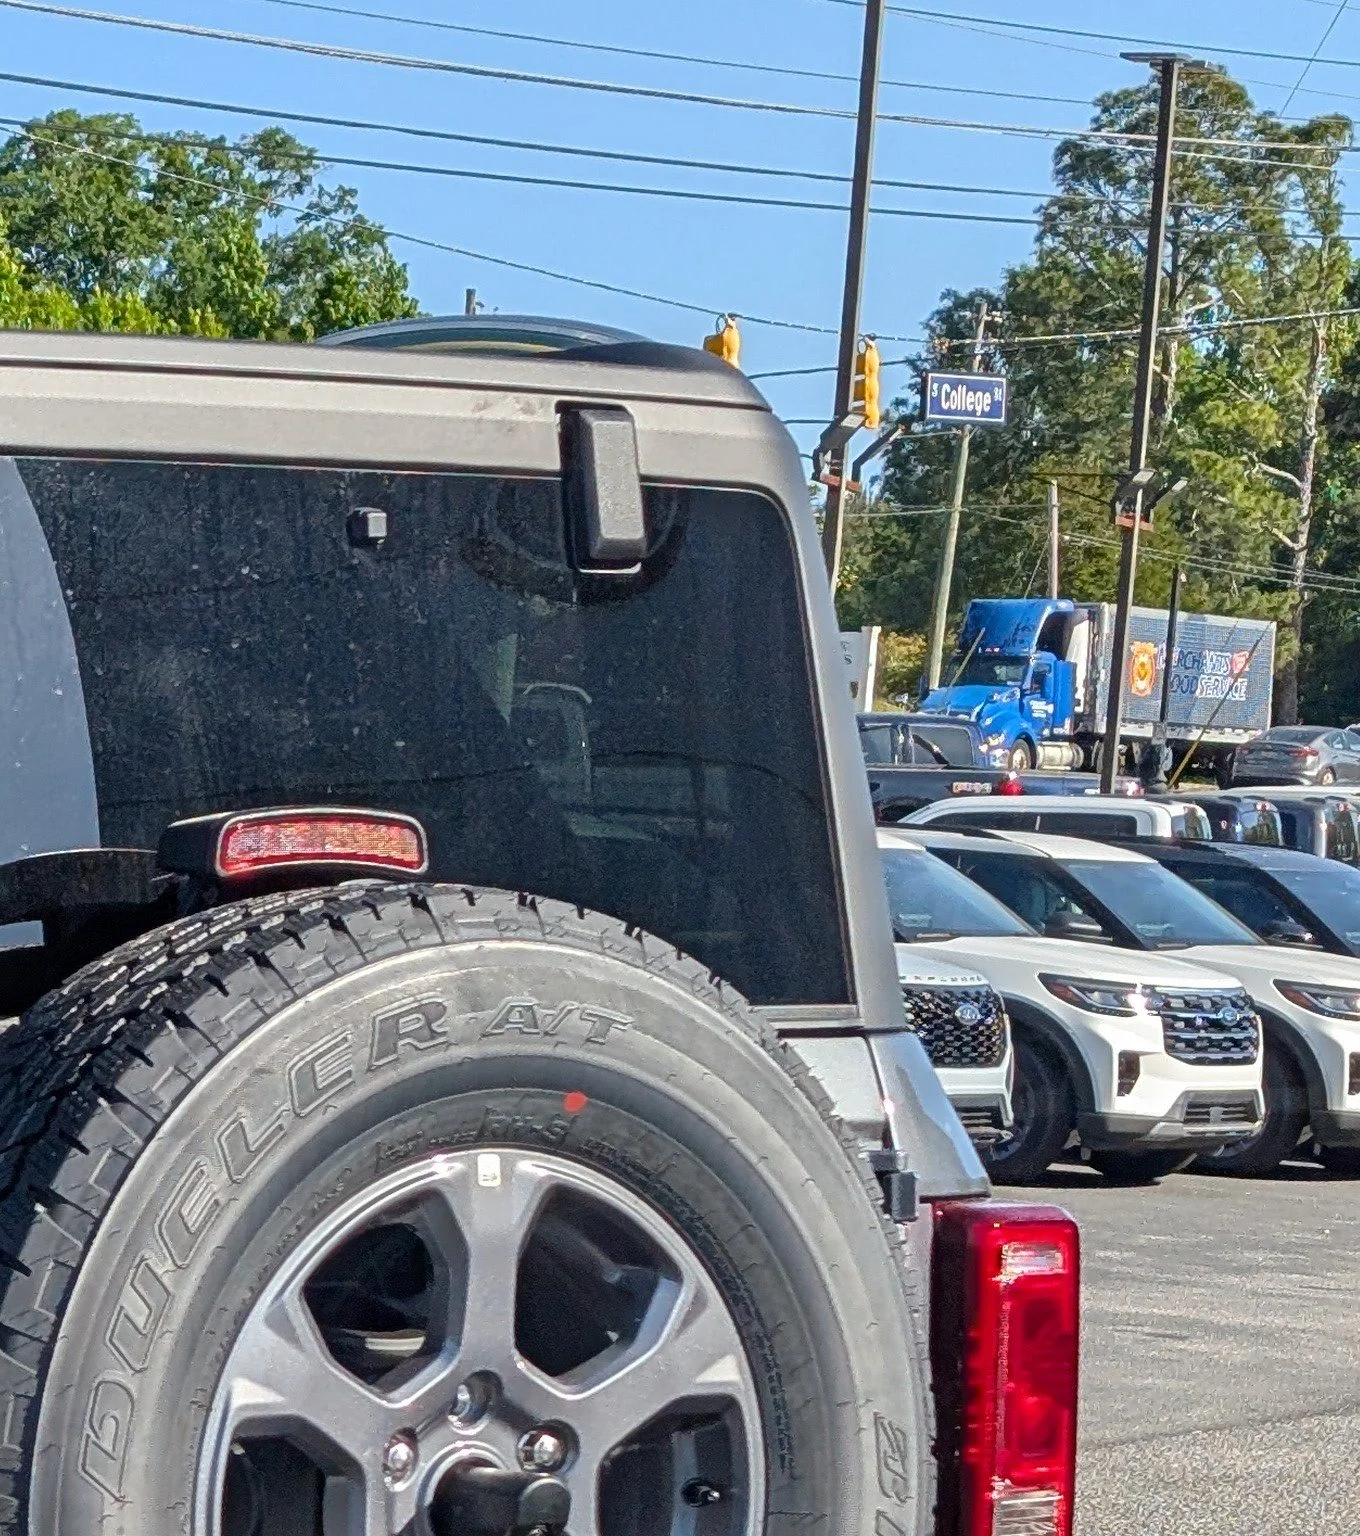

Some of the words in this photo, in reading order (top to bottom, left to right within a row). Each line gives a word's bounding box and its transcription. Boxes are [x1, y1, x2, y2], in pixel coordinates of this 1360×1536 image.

[931, 382, 939, 397] S
[941, 383, 992, 416] College
[79, 992, 453, 1502] DUELER
[481, 996, 634, 1047] A/T
